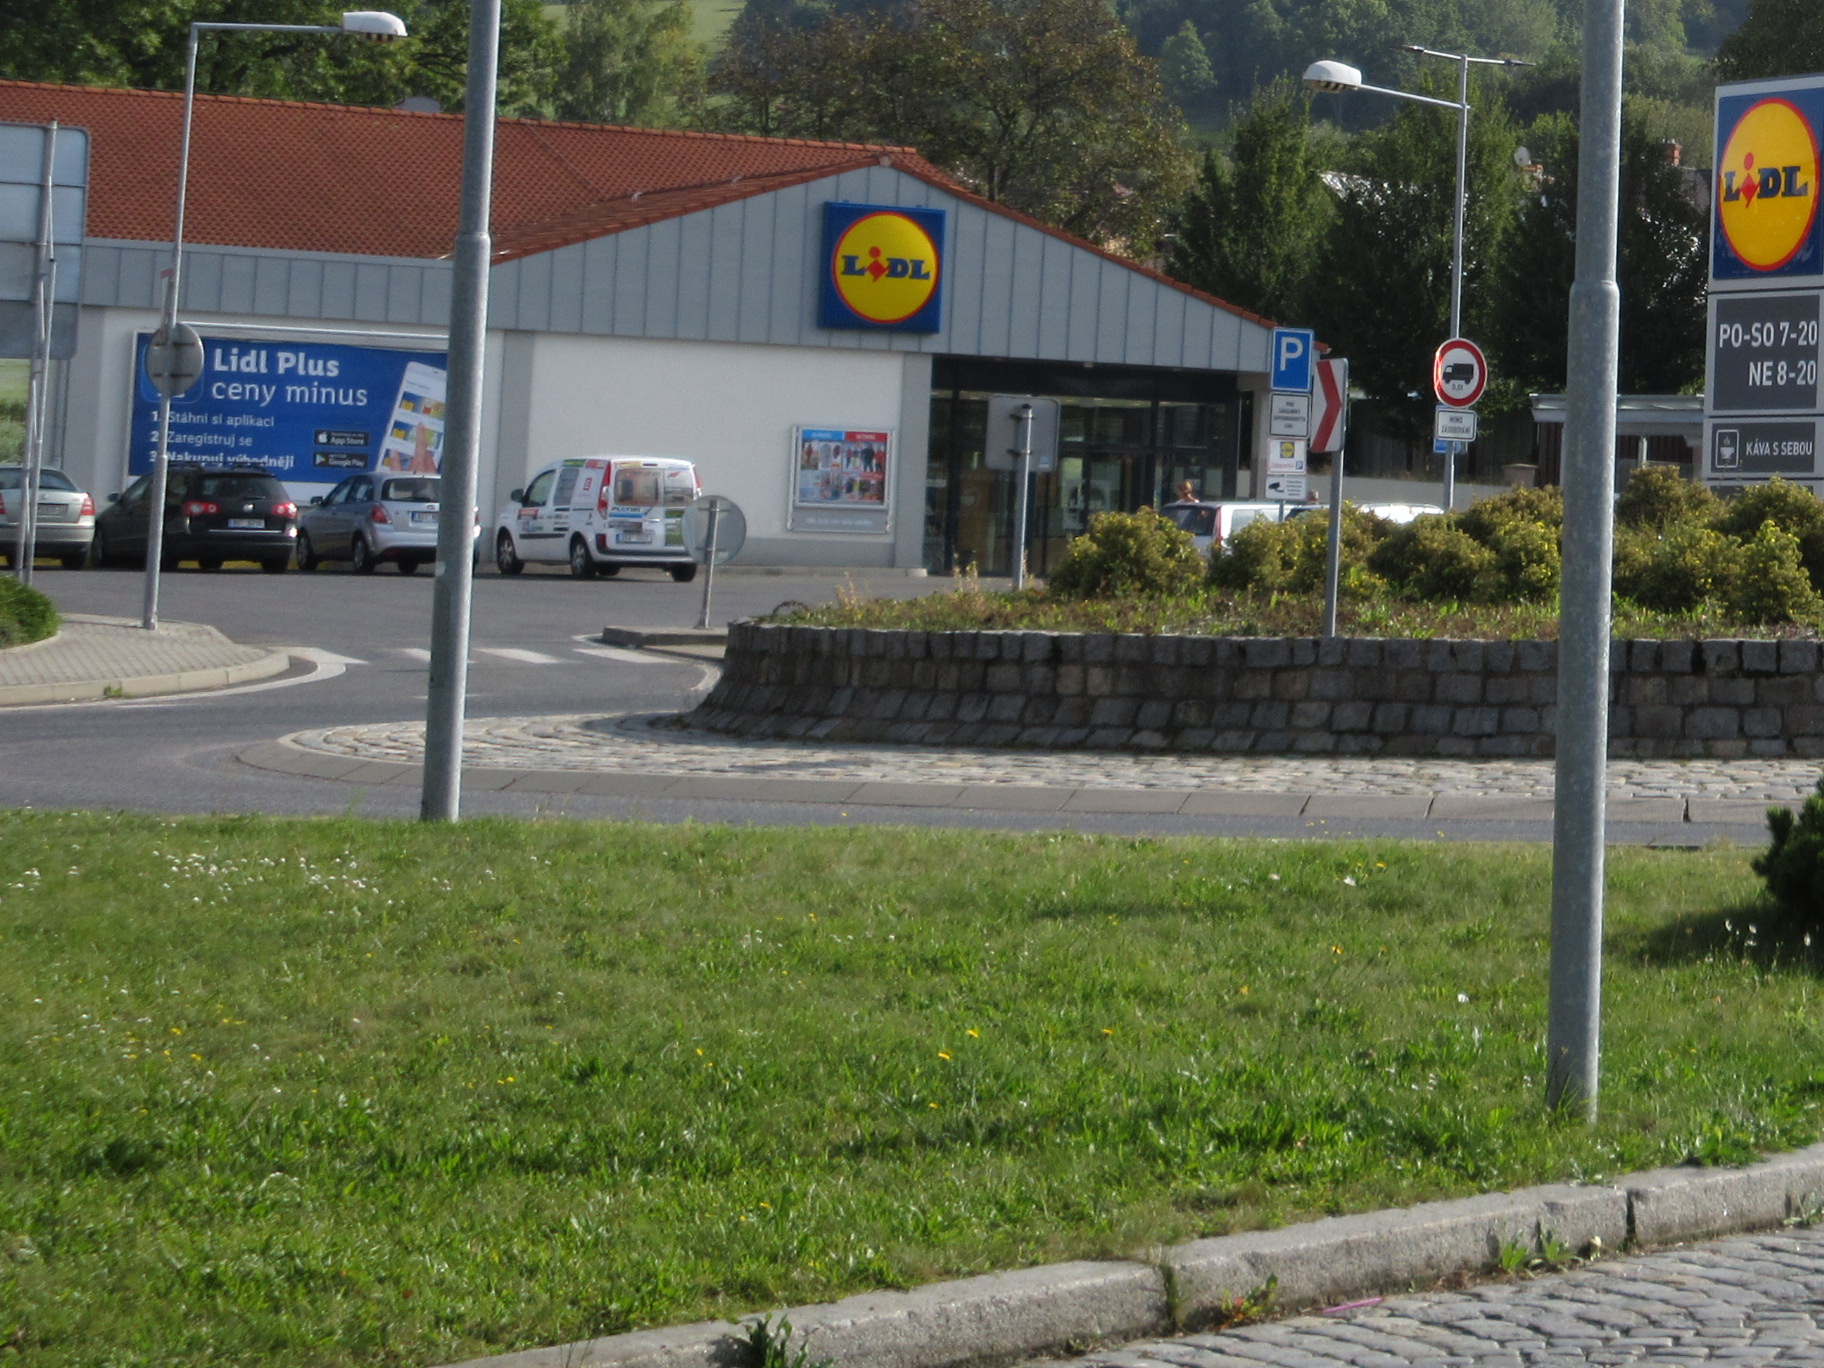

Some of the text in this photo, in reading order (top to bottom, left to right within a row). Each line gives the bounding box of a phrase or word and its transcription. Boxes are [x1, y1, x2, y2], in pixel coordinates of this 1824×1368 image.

[1719, 320, 1818, 348] PO-SO 7-20
[214, 348, 340, 377] Lidl Plus
[1280, 336, 1304, 372] P
[1749, 360, 1817, 386] NE 8-20
[212, 382, 368, 407] ceny minus
[169, 411, 208, 424] Stáhni
[212, 414, 223, 424] si
[226, 415, 275, 428] aplikaci
[168, 431, 236, 447] Zaregistruj
[239, 436, 253, 446] se
[1746, 438, 1813, 456] KÁVA S SEBOU
